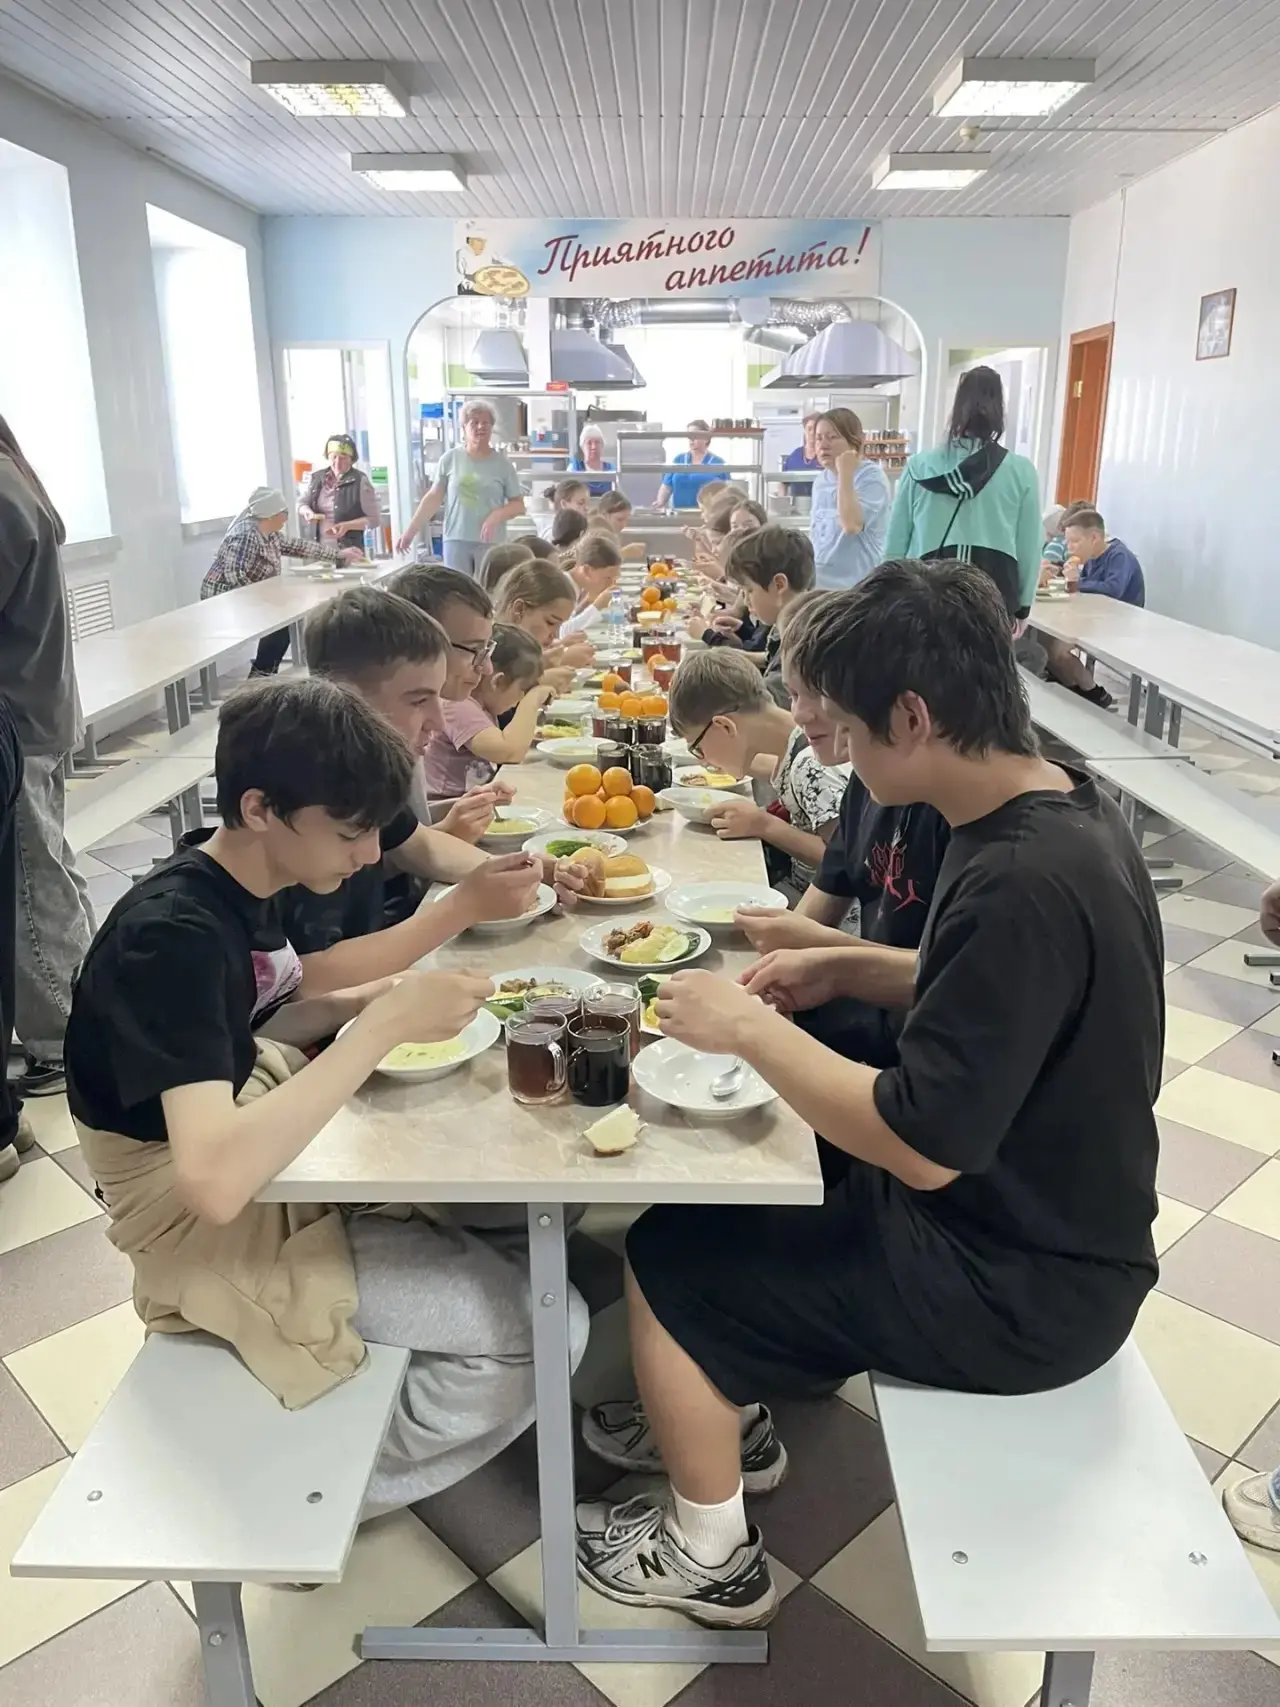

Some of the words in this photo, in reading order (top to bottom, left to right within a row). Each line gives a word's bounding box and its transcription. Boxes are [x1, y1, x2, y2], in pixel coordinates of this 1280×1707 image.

[537, 225, 736, 282] Приятного
[664, 226, 872, 291] аппетита!
[636, 1550, 667, 1579] N
